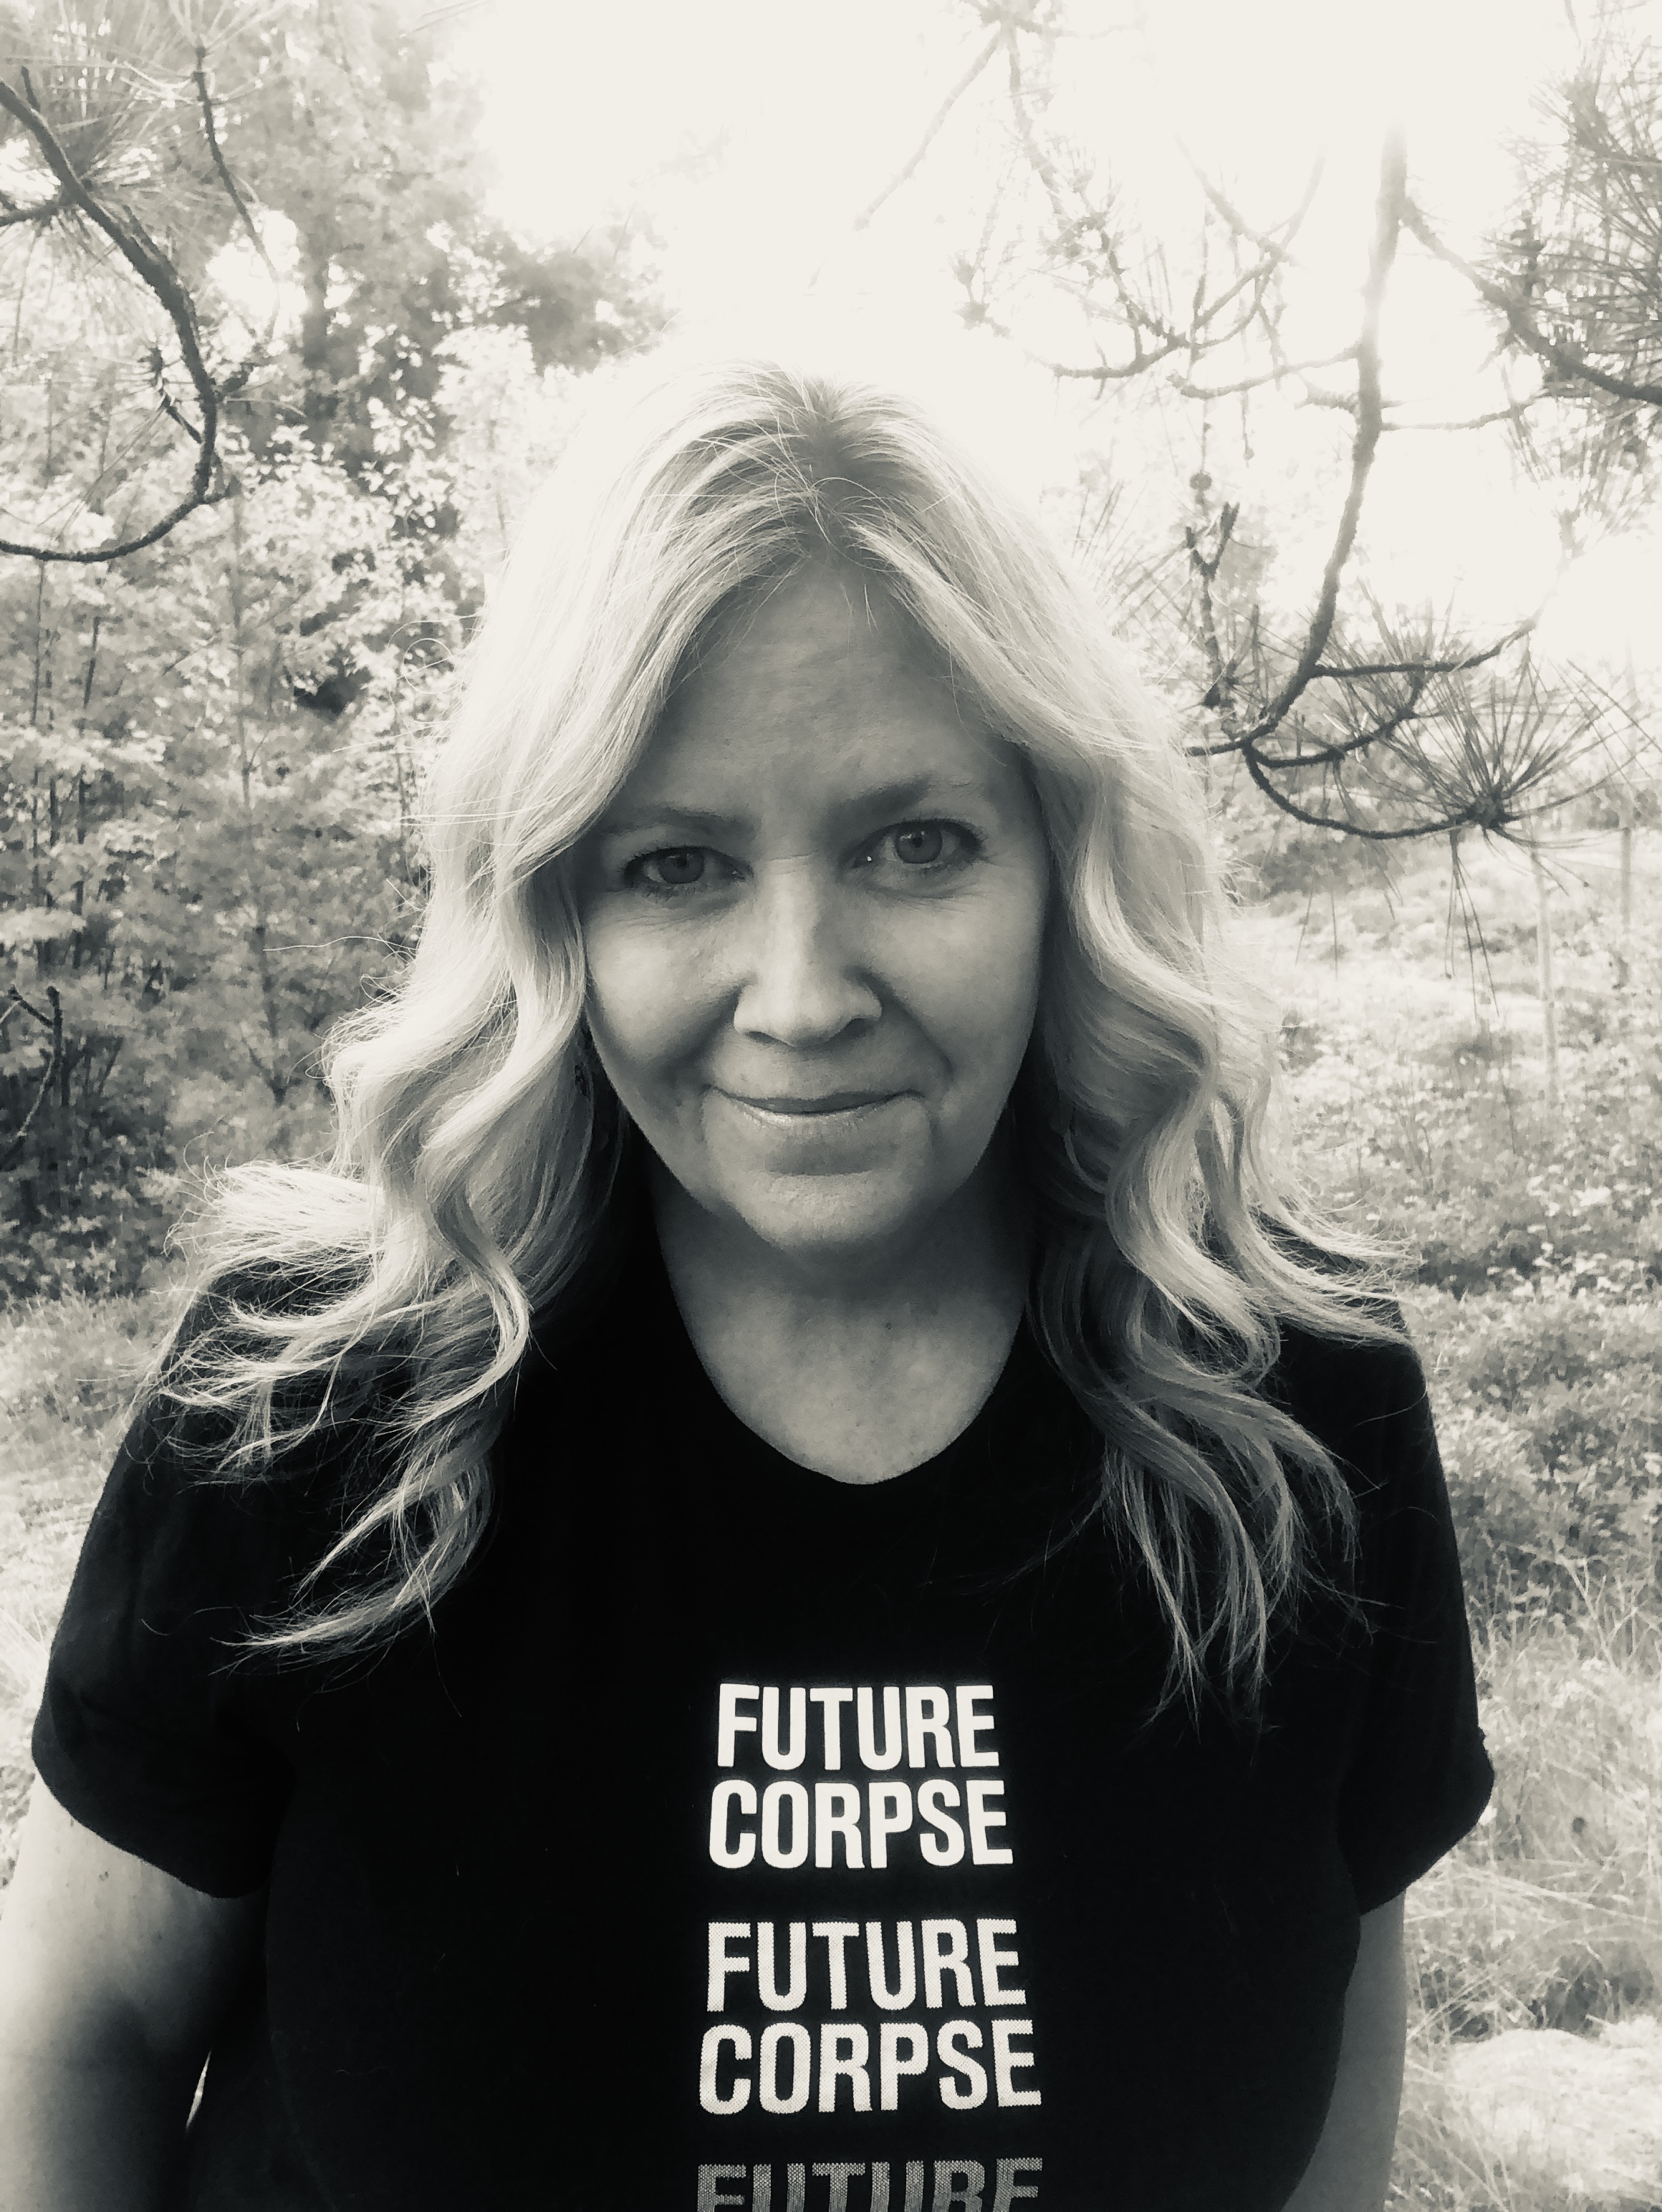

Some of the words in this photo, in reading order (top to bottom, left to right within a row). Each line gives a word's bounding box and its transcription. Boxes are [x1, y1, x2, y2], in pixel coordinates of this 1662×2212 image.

[718, 1683, 999, 1771] FUTURE
[709, 1778, 1013, 1868] CORPSE
[706, 1918, 1026, 2011] FUTURE
[699, 2019, 1042, 2115] CORPSE
